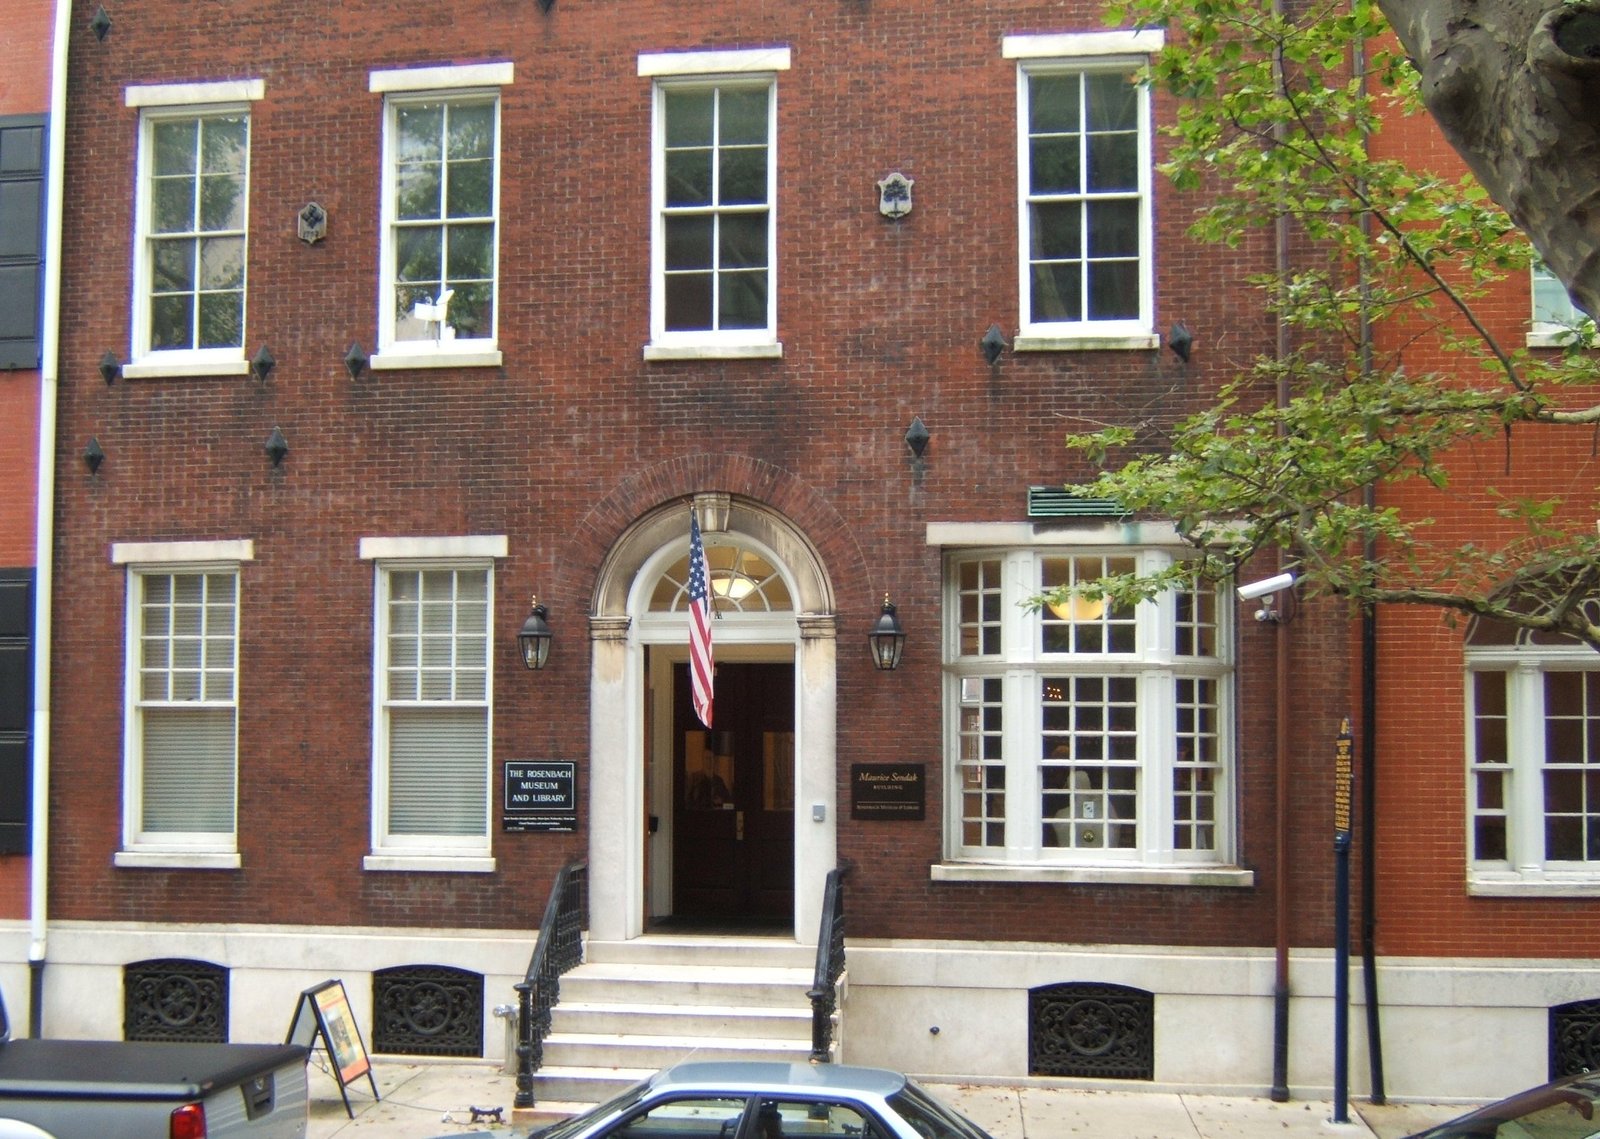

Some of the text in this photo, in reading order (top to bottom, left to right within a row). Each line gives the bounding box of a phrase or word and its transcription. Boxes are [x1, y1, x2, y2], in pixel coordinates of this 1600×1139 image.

[509, 769, 571, 778] THE ROSENBACH
[520, 781, 558, 790] MUSEUM
[512, 794, 566, 802] AND LIBRARY
